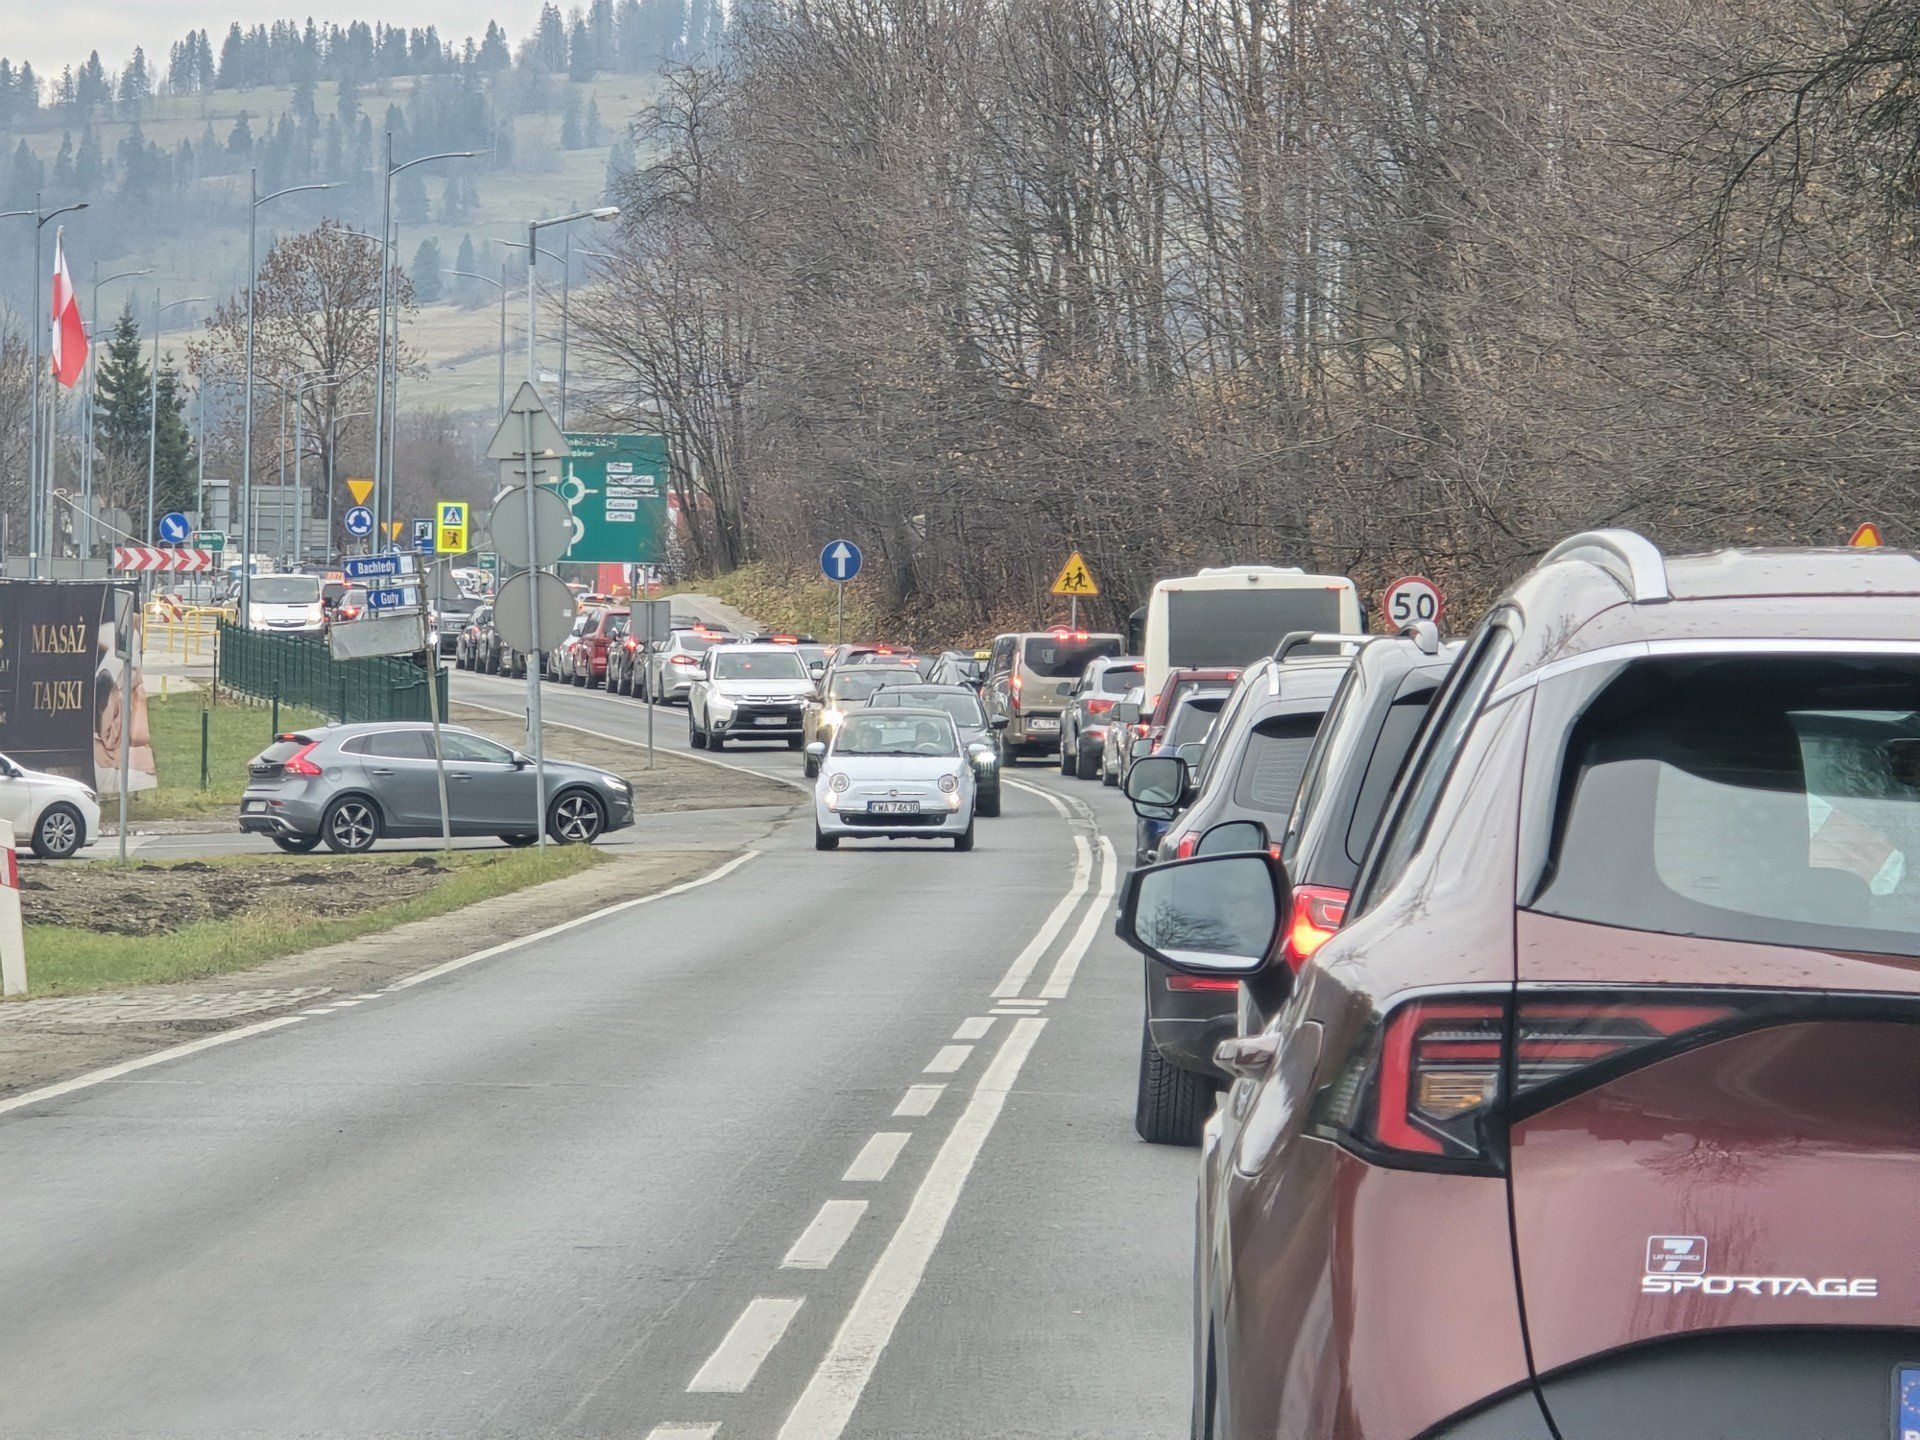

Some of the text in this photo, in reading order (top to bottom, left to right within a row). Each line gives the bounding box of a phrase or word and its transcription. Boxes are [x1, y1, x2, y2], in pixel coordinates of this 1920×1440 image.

[357, 560, 396, 575] Bachledy
[380, 591, 399, 605] Guty
[1393, 592, 1435, 620] 50
[31, 616, 86, 653] MASAŻ
[32, 681, 83, 718] TAJSKI
[1641, 1275, 1879, 1298] SPORTAGE
